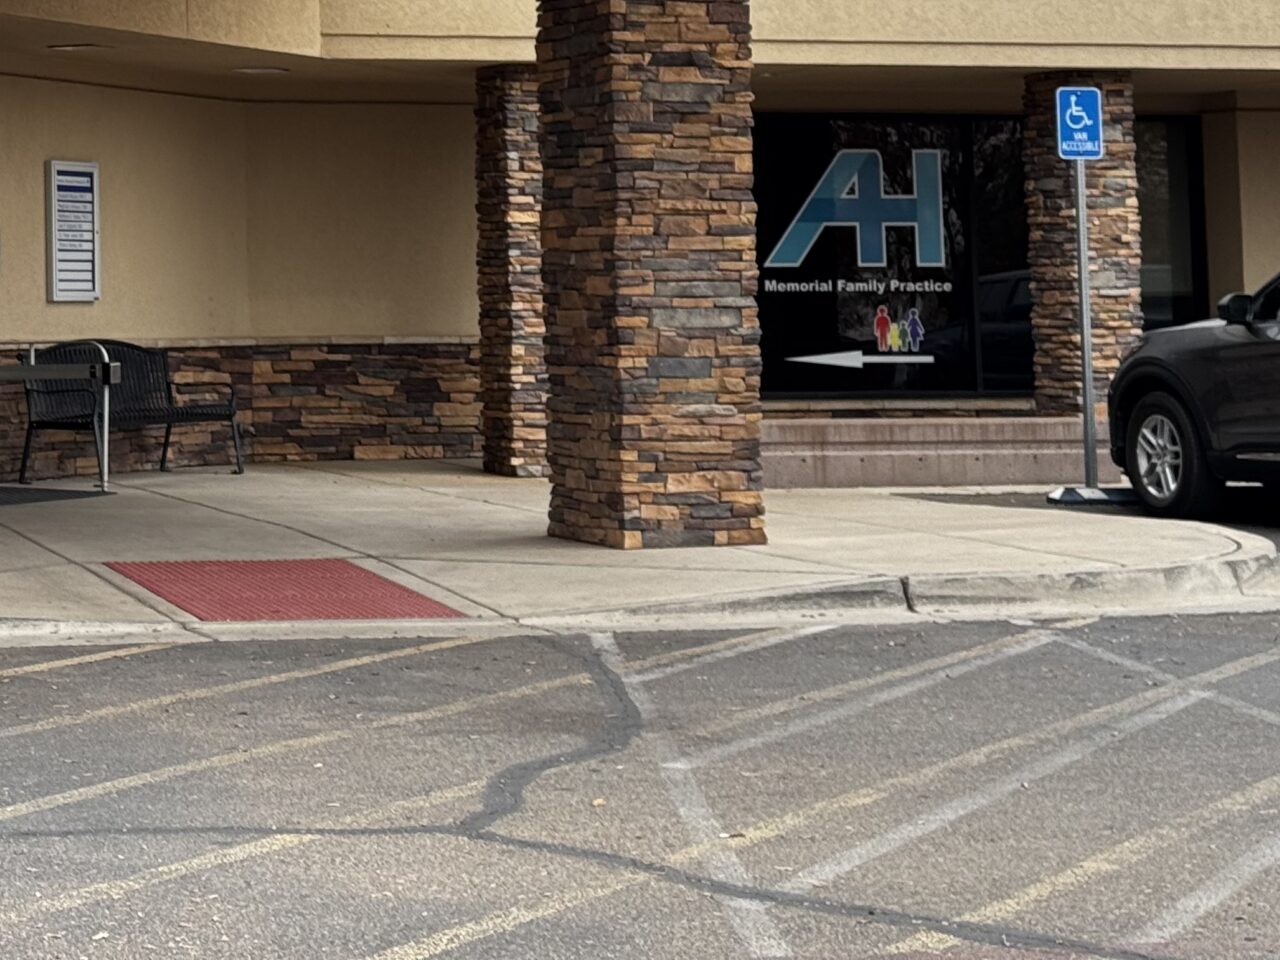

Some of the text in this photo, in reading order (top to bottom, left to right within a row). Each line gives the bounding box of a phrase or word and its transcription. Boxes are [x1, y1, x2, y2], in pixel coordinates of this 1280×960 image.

[764, 279, 953, 295] Memorial Family Practice
